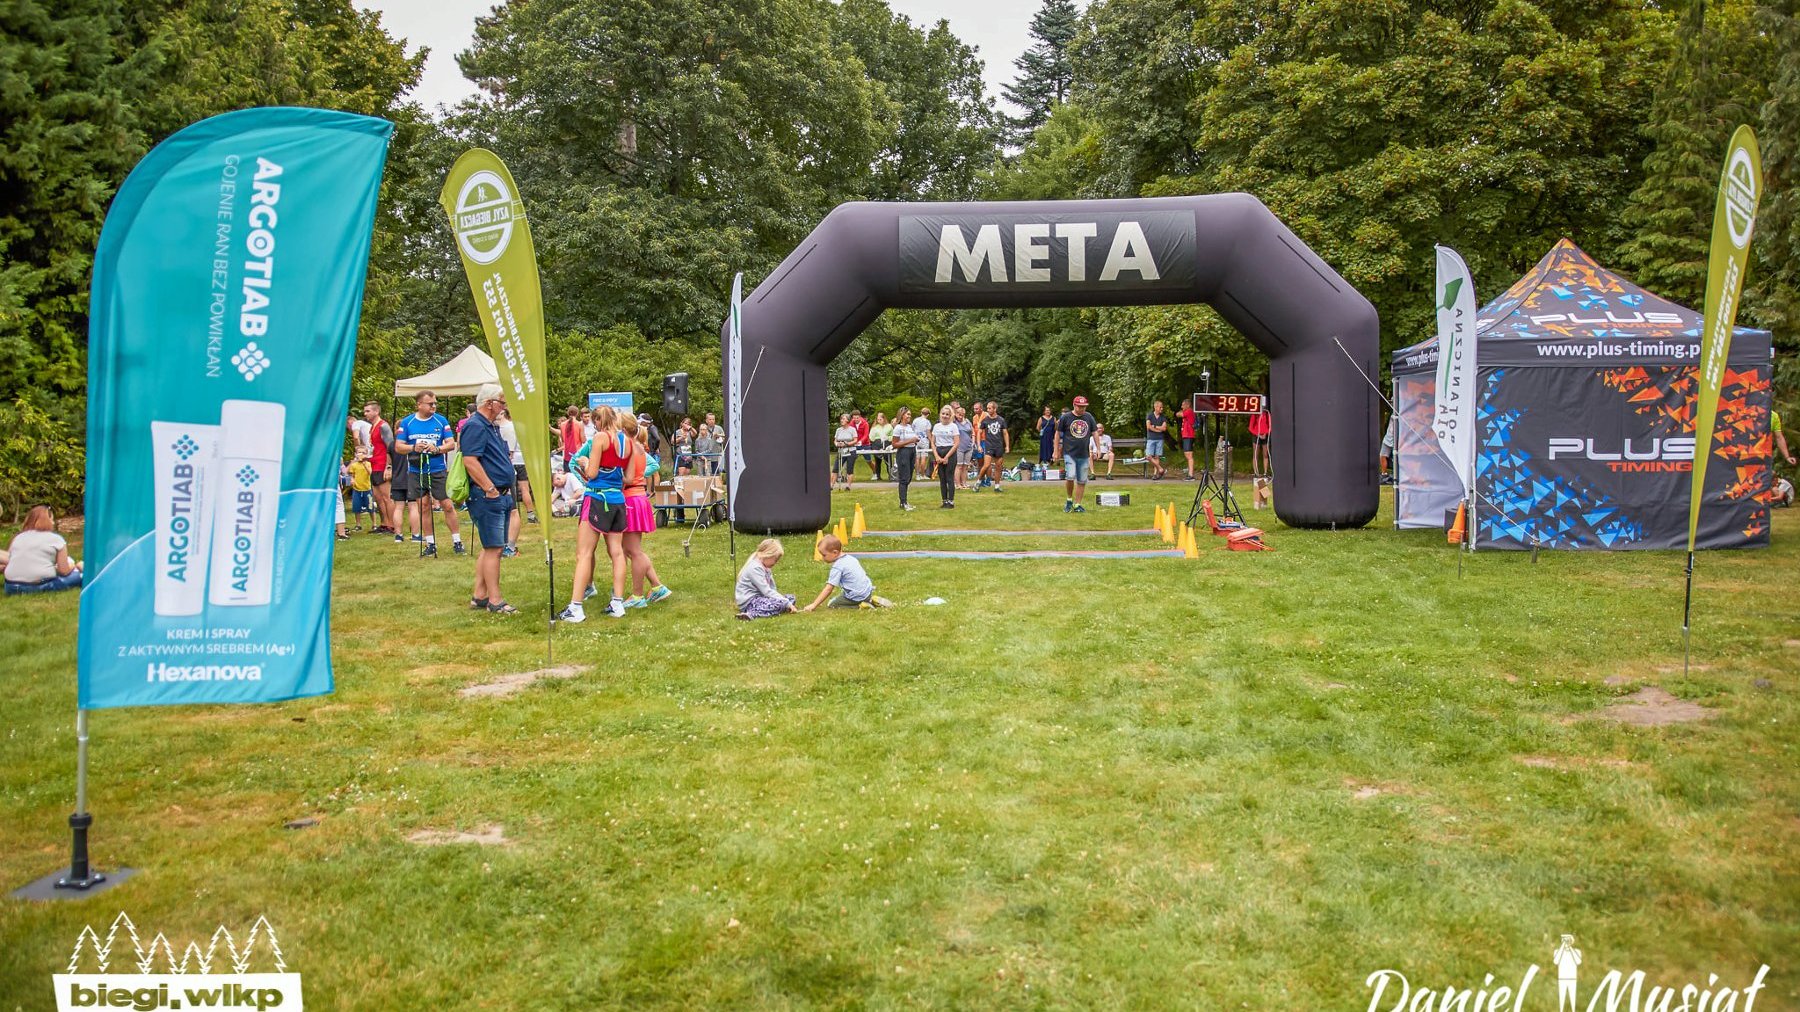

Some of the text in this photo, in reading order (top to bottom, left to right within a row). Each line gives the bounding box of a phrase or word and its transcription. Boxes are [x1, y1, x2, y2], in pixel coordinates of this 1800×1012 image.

[217, 154, 240, 220] GOJENIE
[215, 223, 232, 256] RAN
[240, 157, 284, 336] ARGOTIAB
[935, 222, 1160, 283] META
[212, 258, 228, 290] BEZ
[1530, 311, 1684, 326] PLUS
[1548, 438, 1697, 460] PLUS
[1606, 461, 1693, 472] TIMING
[167, 463, 194, 583] ARGOTIAB
[231, 490, 255, 592] ARGOTIAB
[118, 643, 296, 657] Z AKTYWNYM SREBREM (Ag+)
[166, 629, 204, 640] KREM
[211, 628, 251, 639] SPRAY
[147, 662, 262, 682] Hexanova
